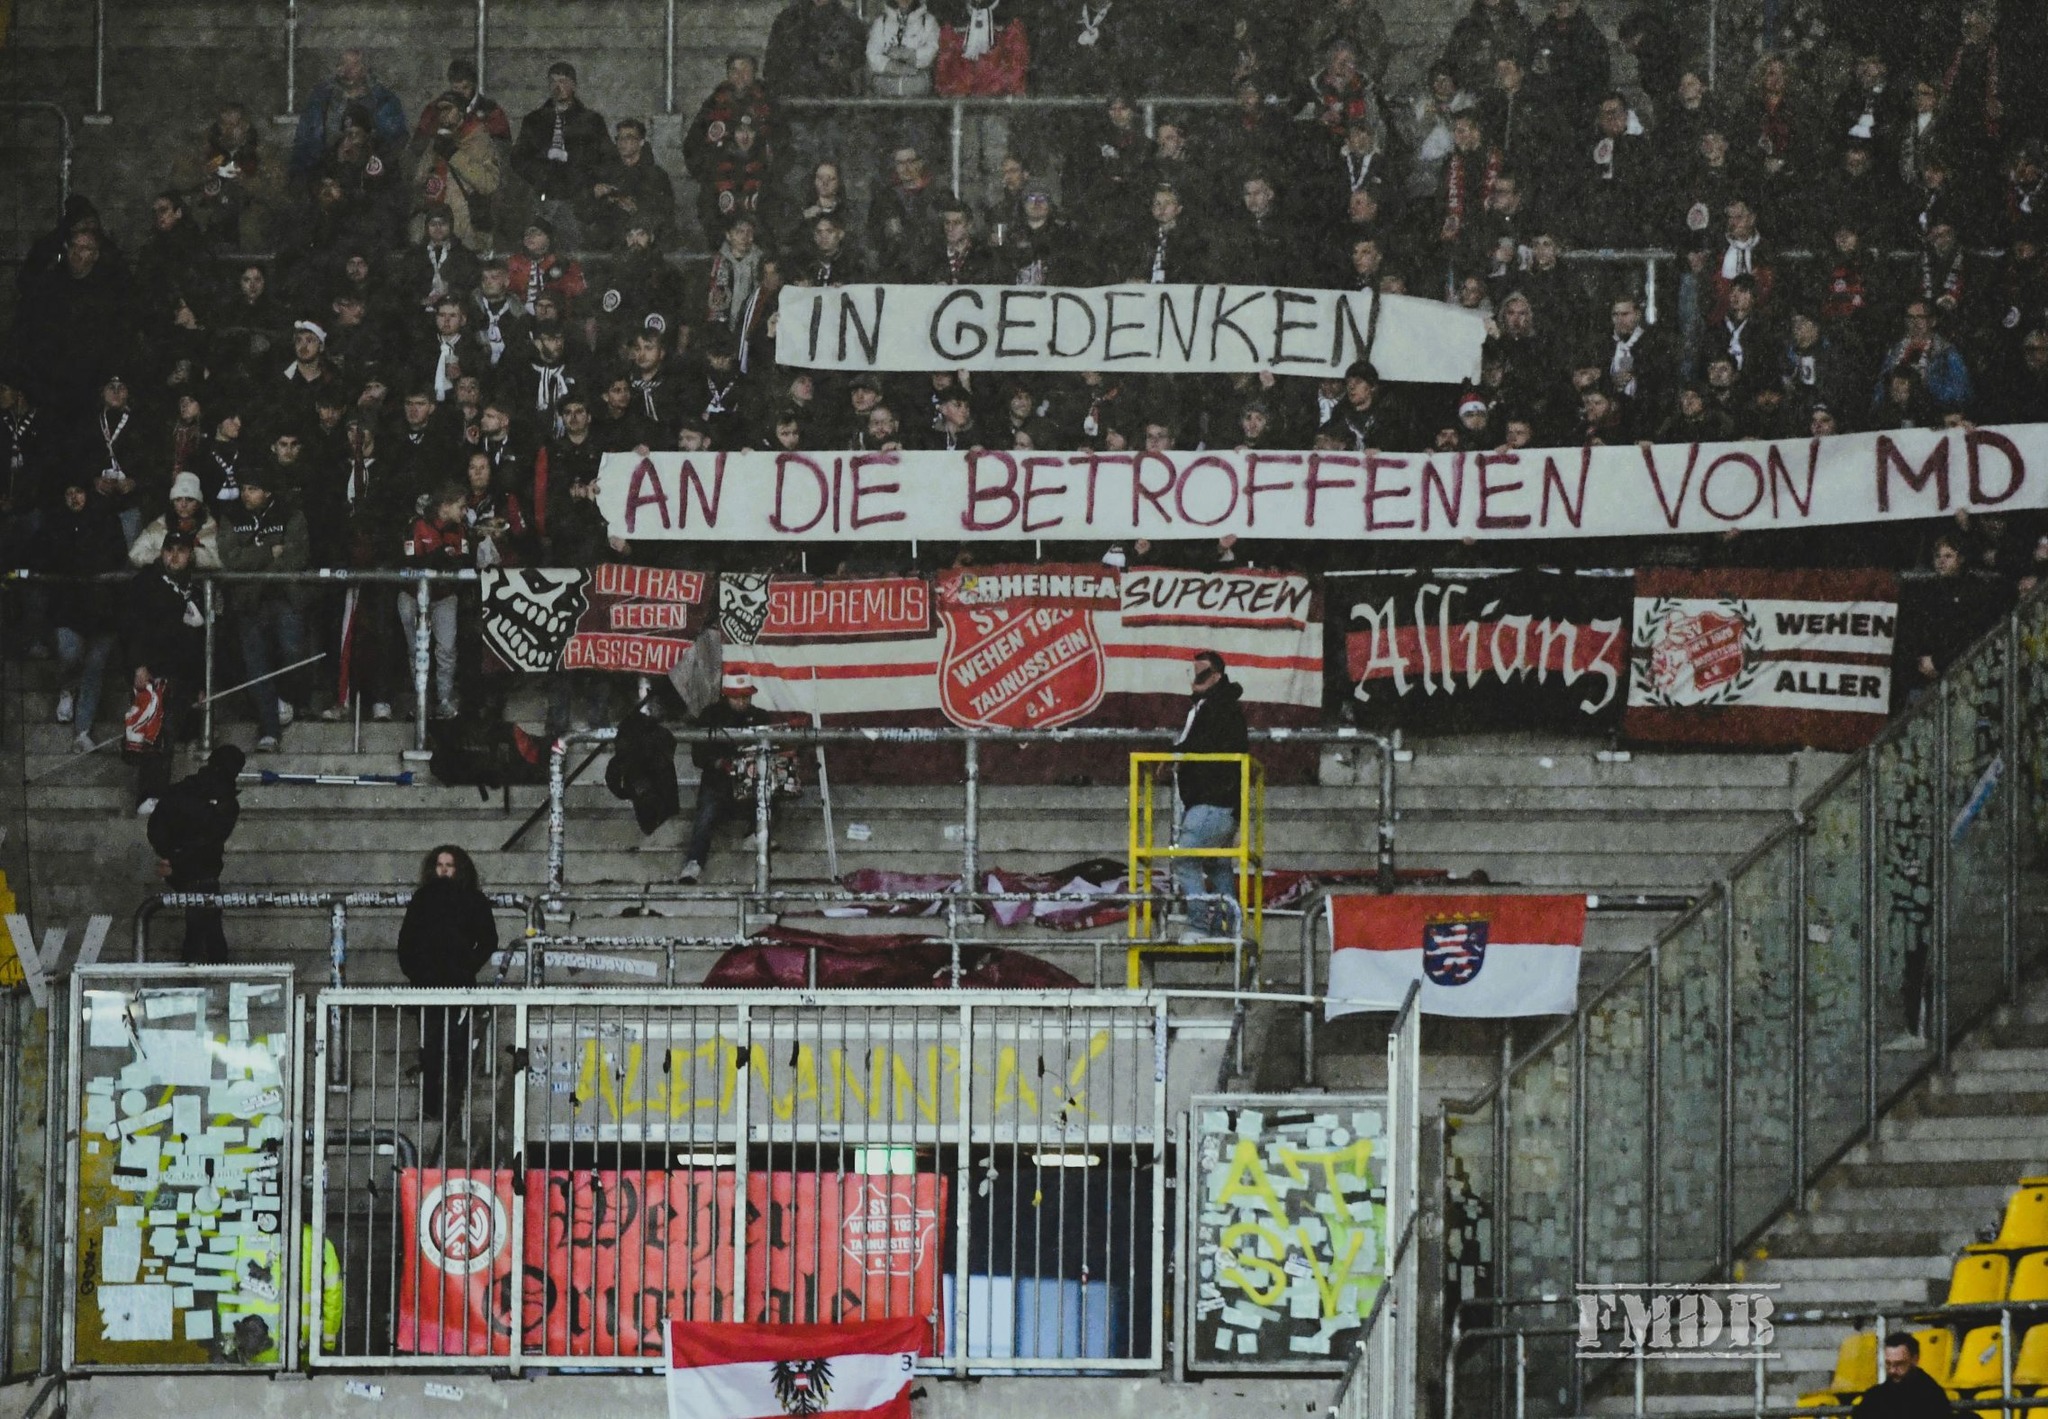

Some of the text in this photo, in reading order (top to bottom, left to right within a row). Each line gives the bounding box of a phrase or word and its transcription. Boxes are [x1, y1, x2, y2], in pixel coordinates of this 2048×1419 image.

[808, 284, 1381, 367] IN GEDENKEN
[624, 429, 2026, 535] AN DIE BETROFFENEN VON MD
[599, 567, 697, 601] ULTRAS
[1123, 575, 1312, 614] SUPCREW
[614, 604, 686, 628] GEGEN
[770, 586, 926, 626] SUPREMUS
[1774, 612, 1895, 639] WEHEN
[567, 639, 689, 671] RASSISMU
[951, 627, 1026, 688] WEHEN
[1350, 583, 1622, 715] Allianz
[968, 627, 1090, 716] TAUNUSSTEIN
[1774, 669, 1882, 699] ALLER
